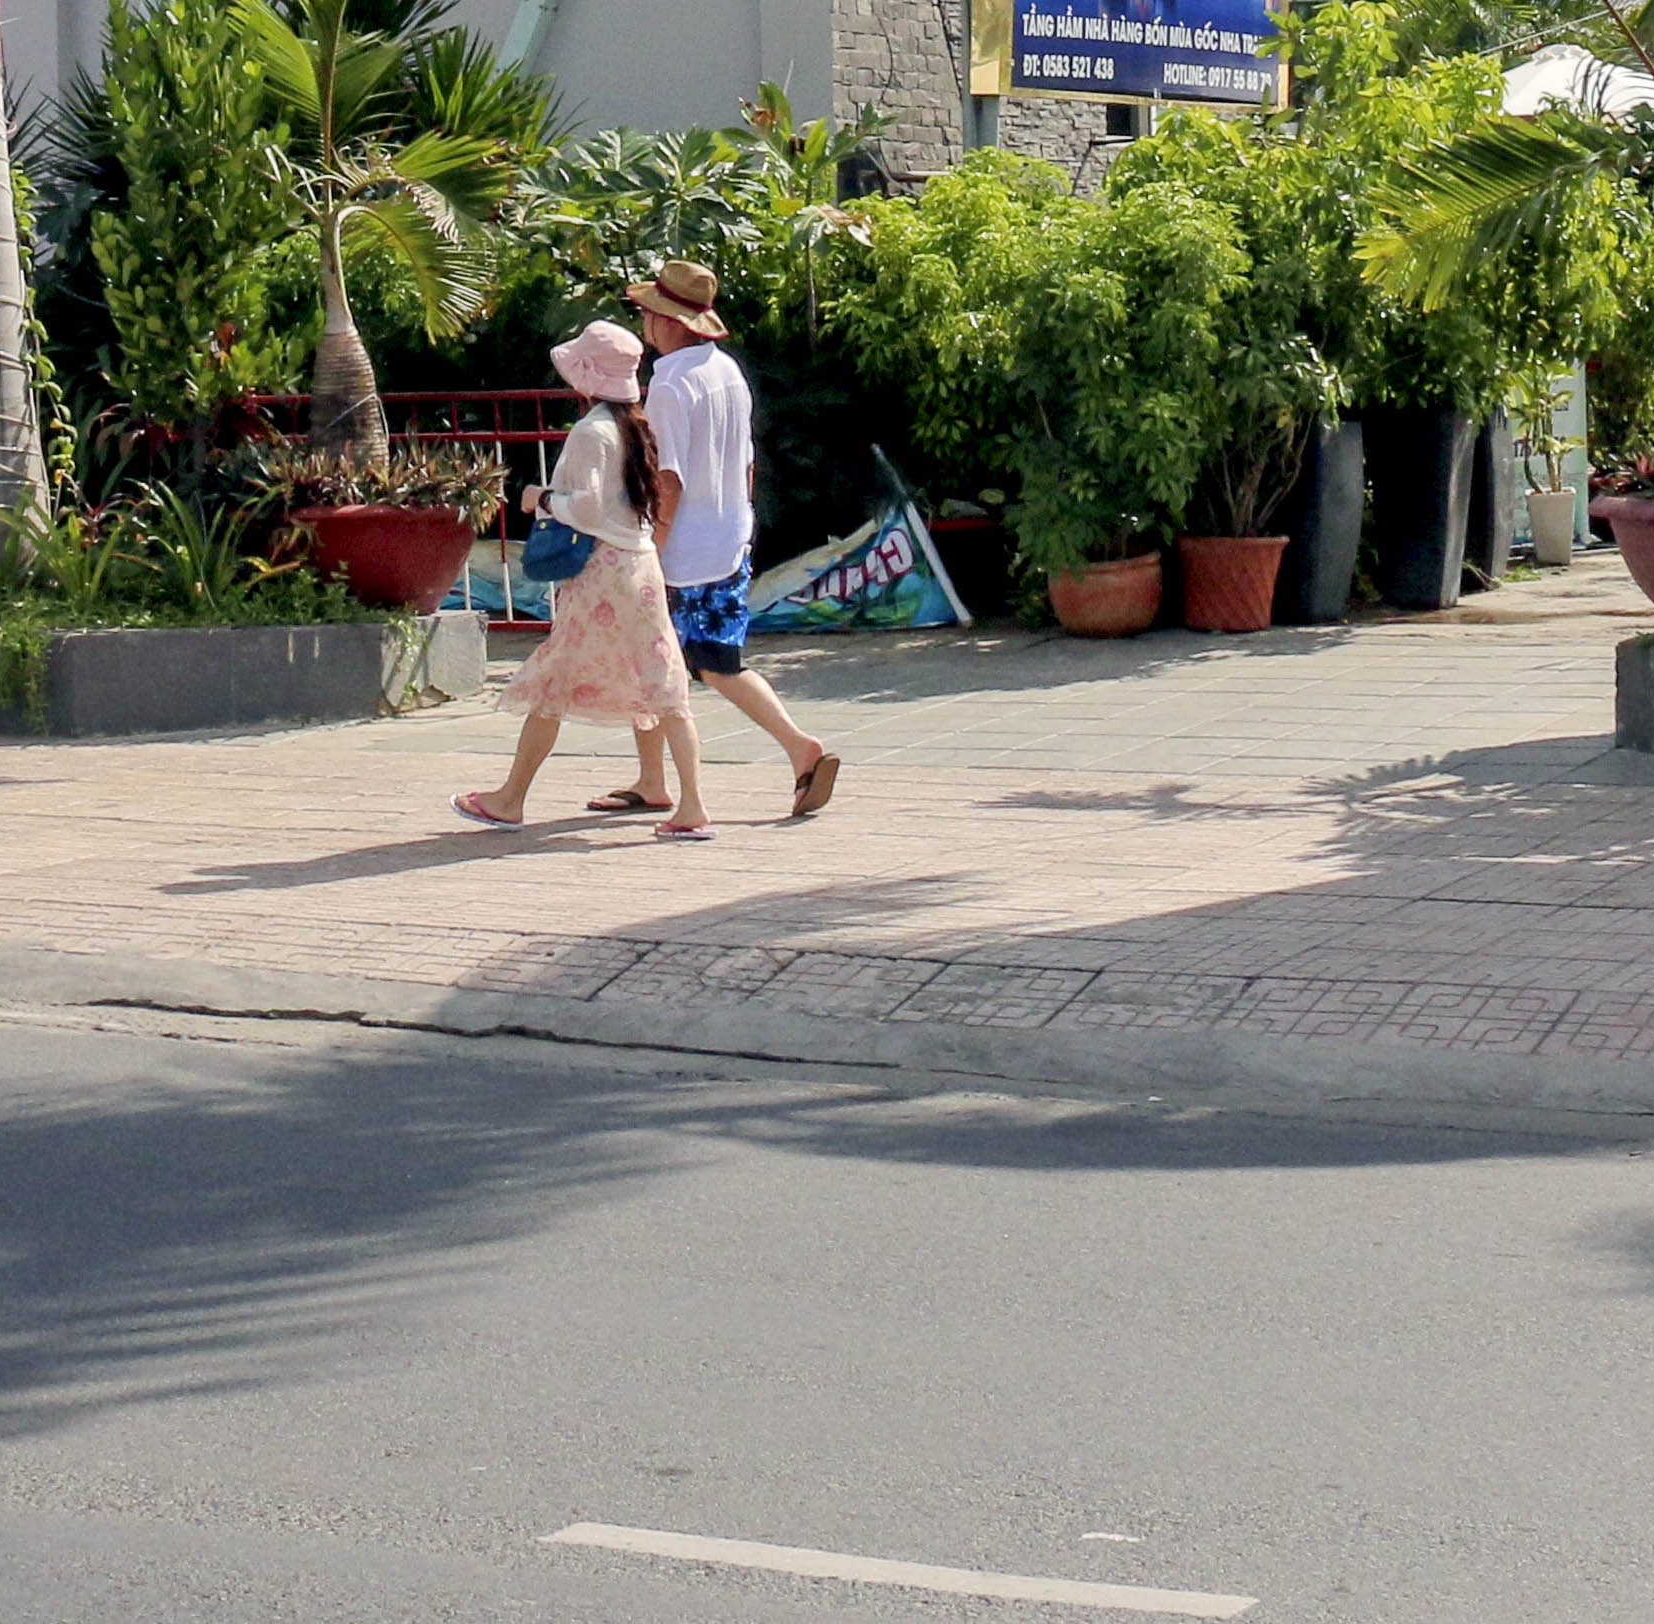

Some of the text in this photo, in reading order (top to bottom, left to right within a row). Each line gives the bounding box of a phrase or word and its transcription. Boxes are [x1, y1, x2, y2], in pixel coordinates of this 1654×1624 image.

[1085, 13, 1109, 42] NHÀ
[1111, 15, 1144, 45] HÀNG
[1146, 16, 1168, 47] BỐN
[1169, 22, 1193, 49] MÙA
[1194, 21, 1219, 52] GỐC
[1220, 31, 1242, 54] NHA
[1022, 54, 1115, 80] ĐT: 0583 521 438
[1164, 63, 1207, 87] HOTLINE:
[1208, 67, 1232, 88] 0917
[1233, 70, 1245, 89] 55
